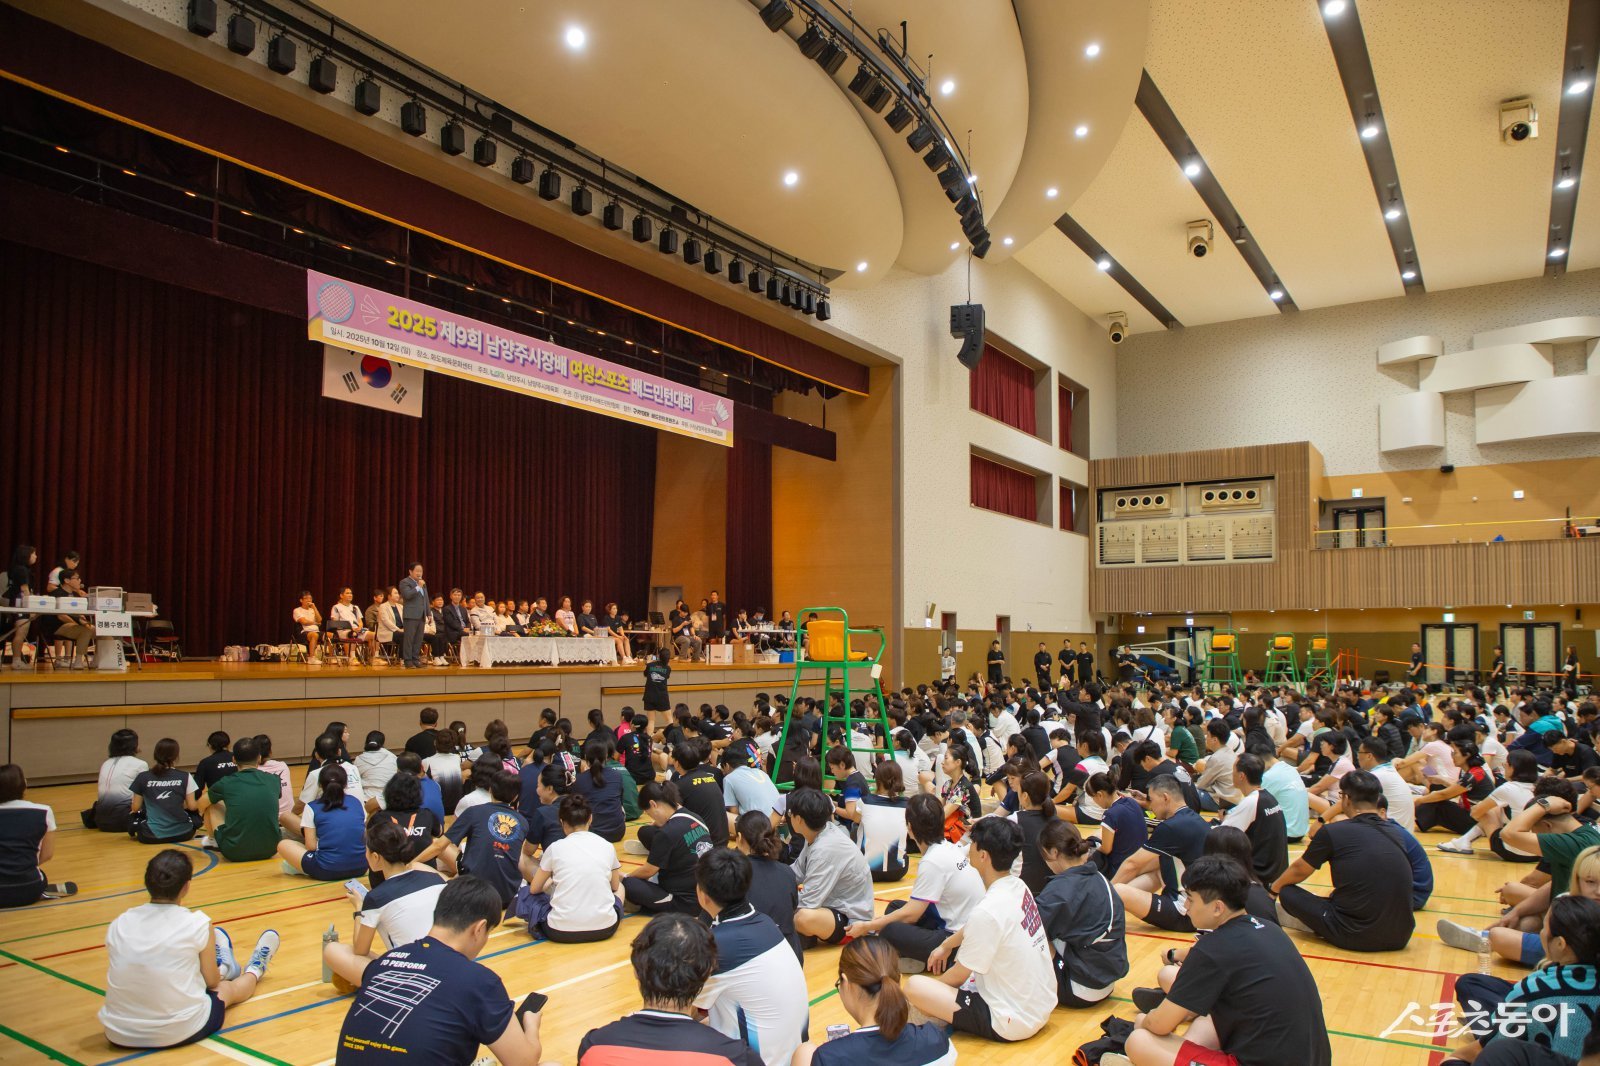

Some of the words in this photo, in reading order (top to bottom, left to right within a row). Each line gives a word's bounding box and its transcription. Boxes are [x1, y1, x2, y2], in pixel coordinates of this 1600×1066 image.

[346, 331, 370, 345] 2025년
[371, 338, 386, 349] 10월
[386, 342, 400, 353] 12일
[387, 306, 437, 338] 2025
[440, 320, 483, 354] 제9회
[486, 333, 568, 377] 남양주시장배
[570, 359, 630, 392] 여성스포츠
[631, 378, 695, 412] 배드민턴대회
[146, 780, 182, 788] STROKUS
[380, 959, 389, 967] TO
[388, 960, 427, 971] PERFORM
